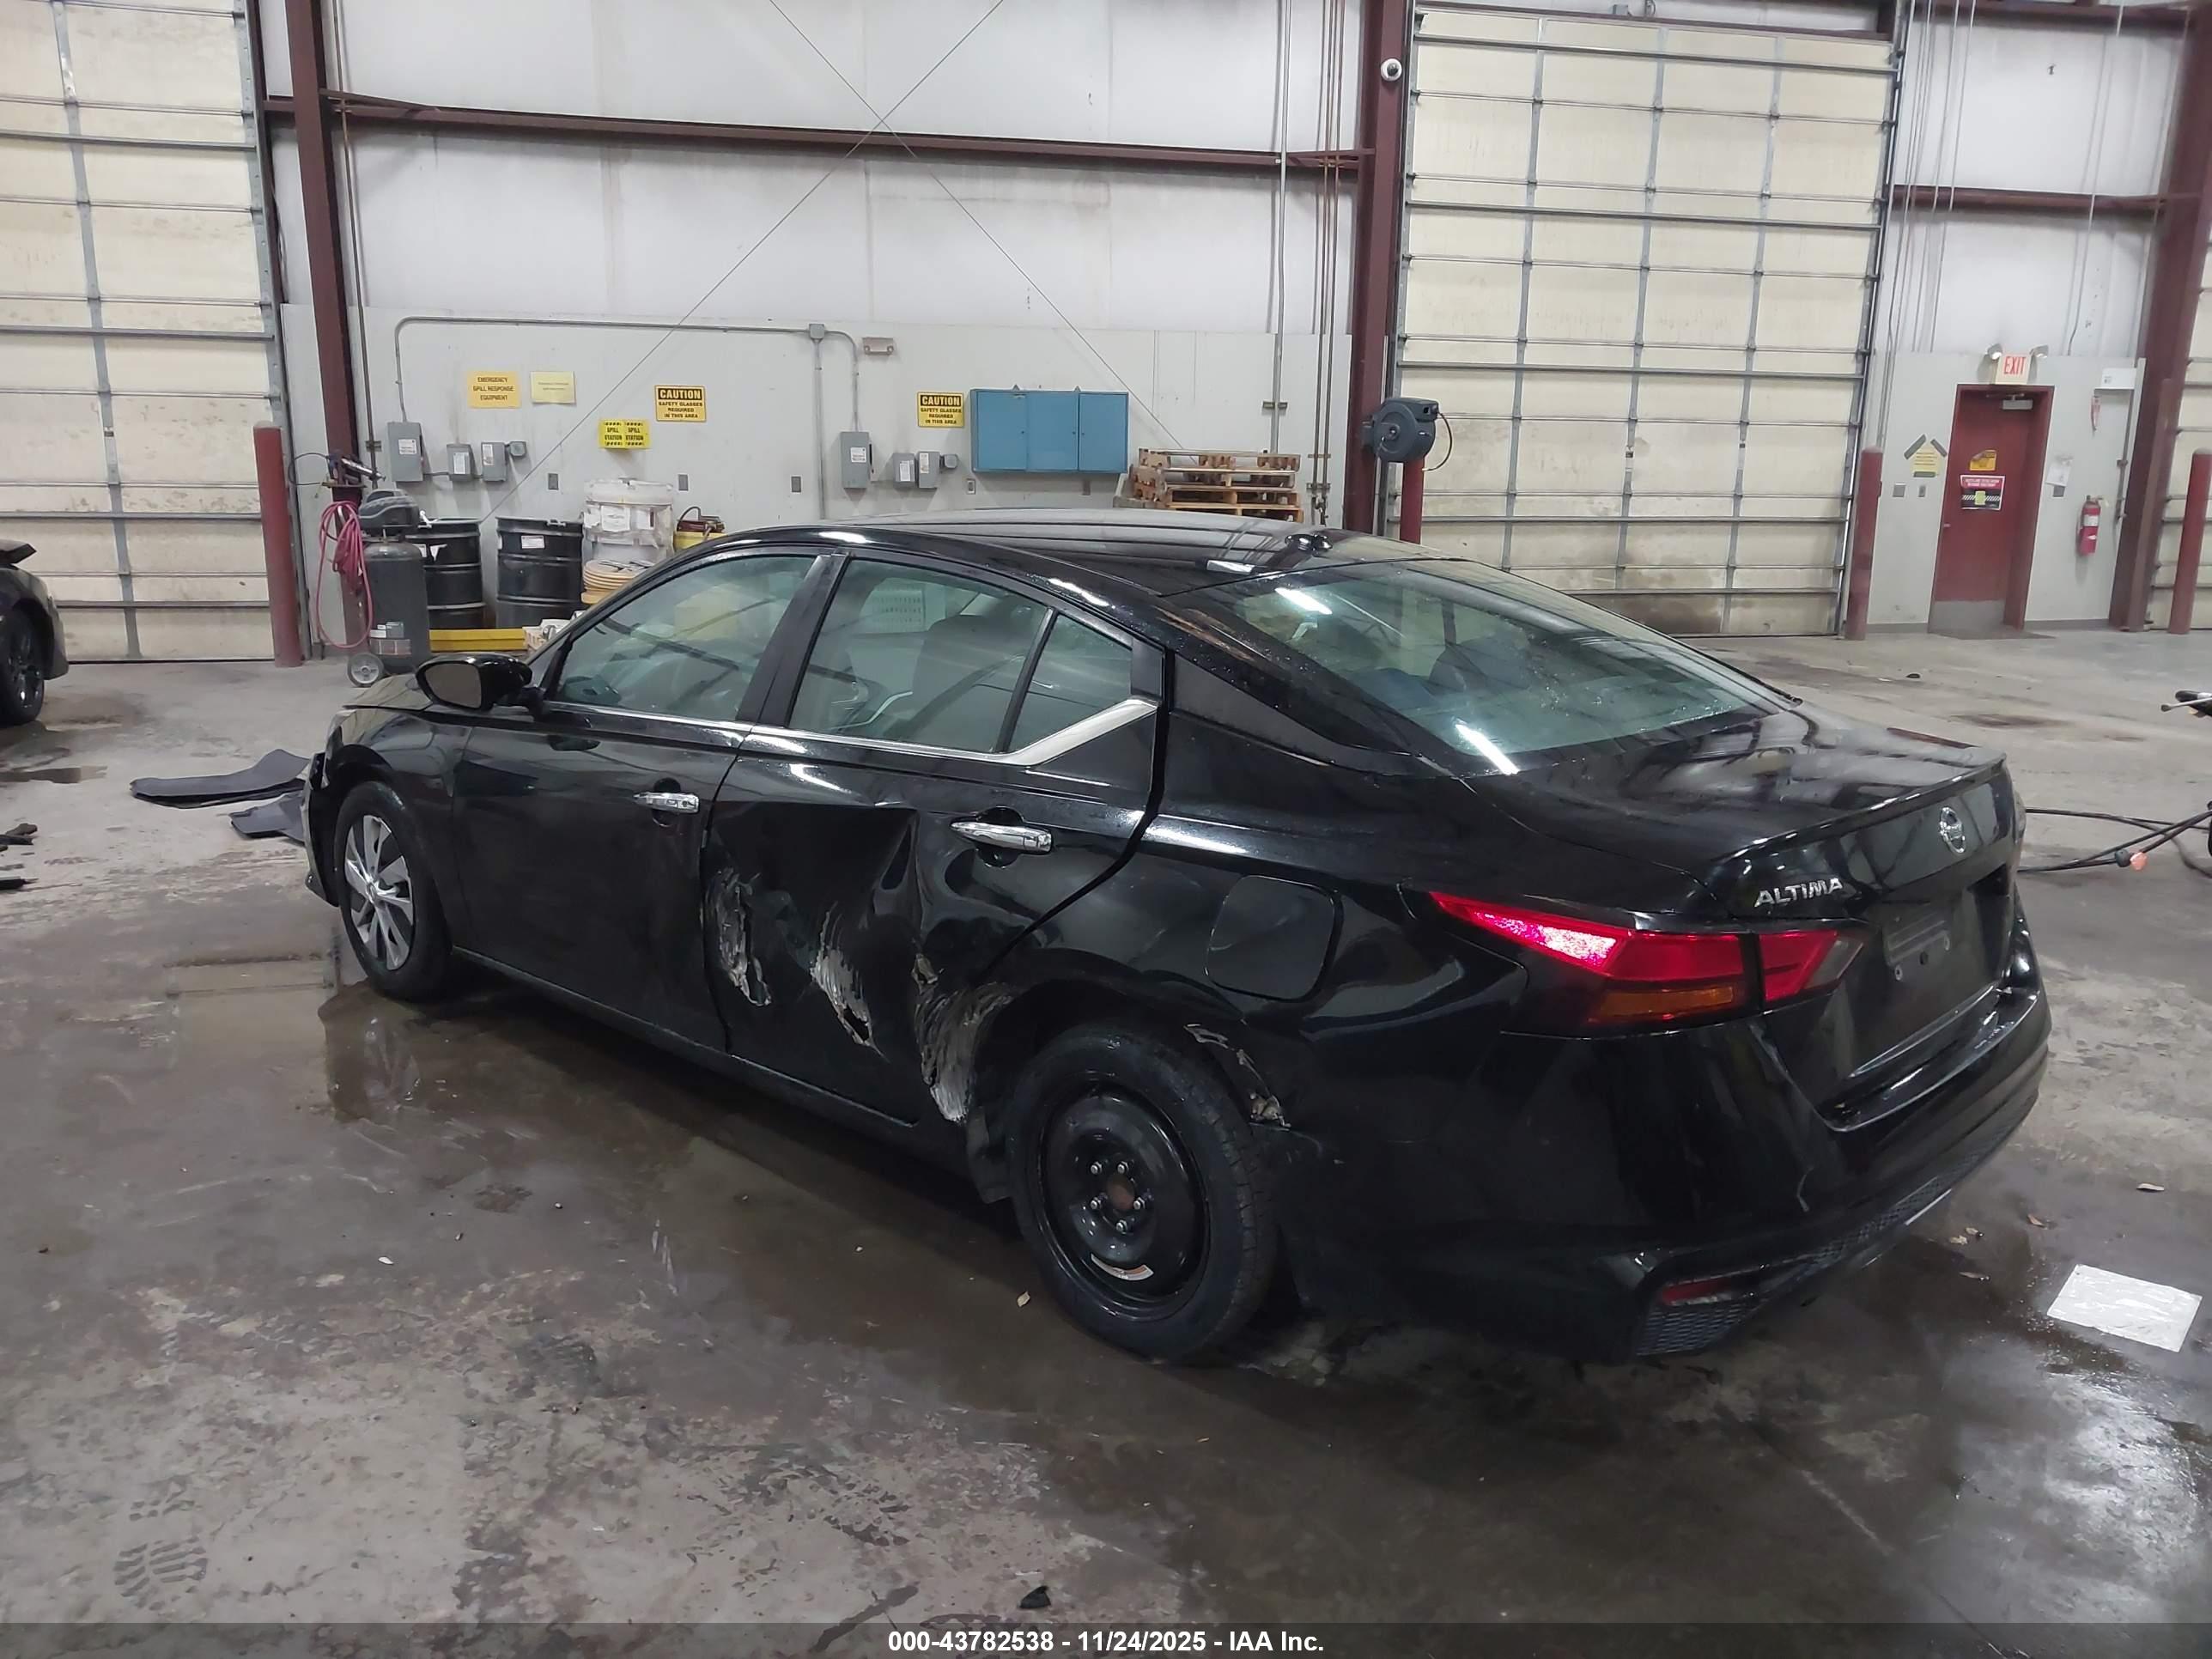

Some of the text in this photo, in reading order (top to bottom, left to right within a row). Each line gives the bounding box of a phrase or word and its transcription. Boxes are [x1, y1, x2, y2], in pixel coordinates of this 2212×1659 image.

[2003, 356, 2027, 374] EXIT
[659, 389, 702, 399] CAUTION
[921, 396, 960, 405] CAUTION
[1754, 878, 1843, 908] ALTIMA
